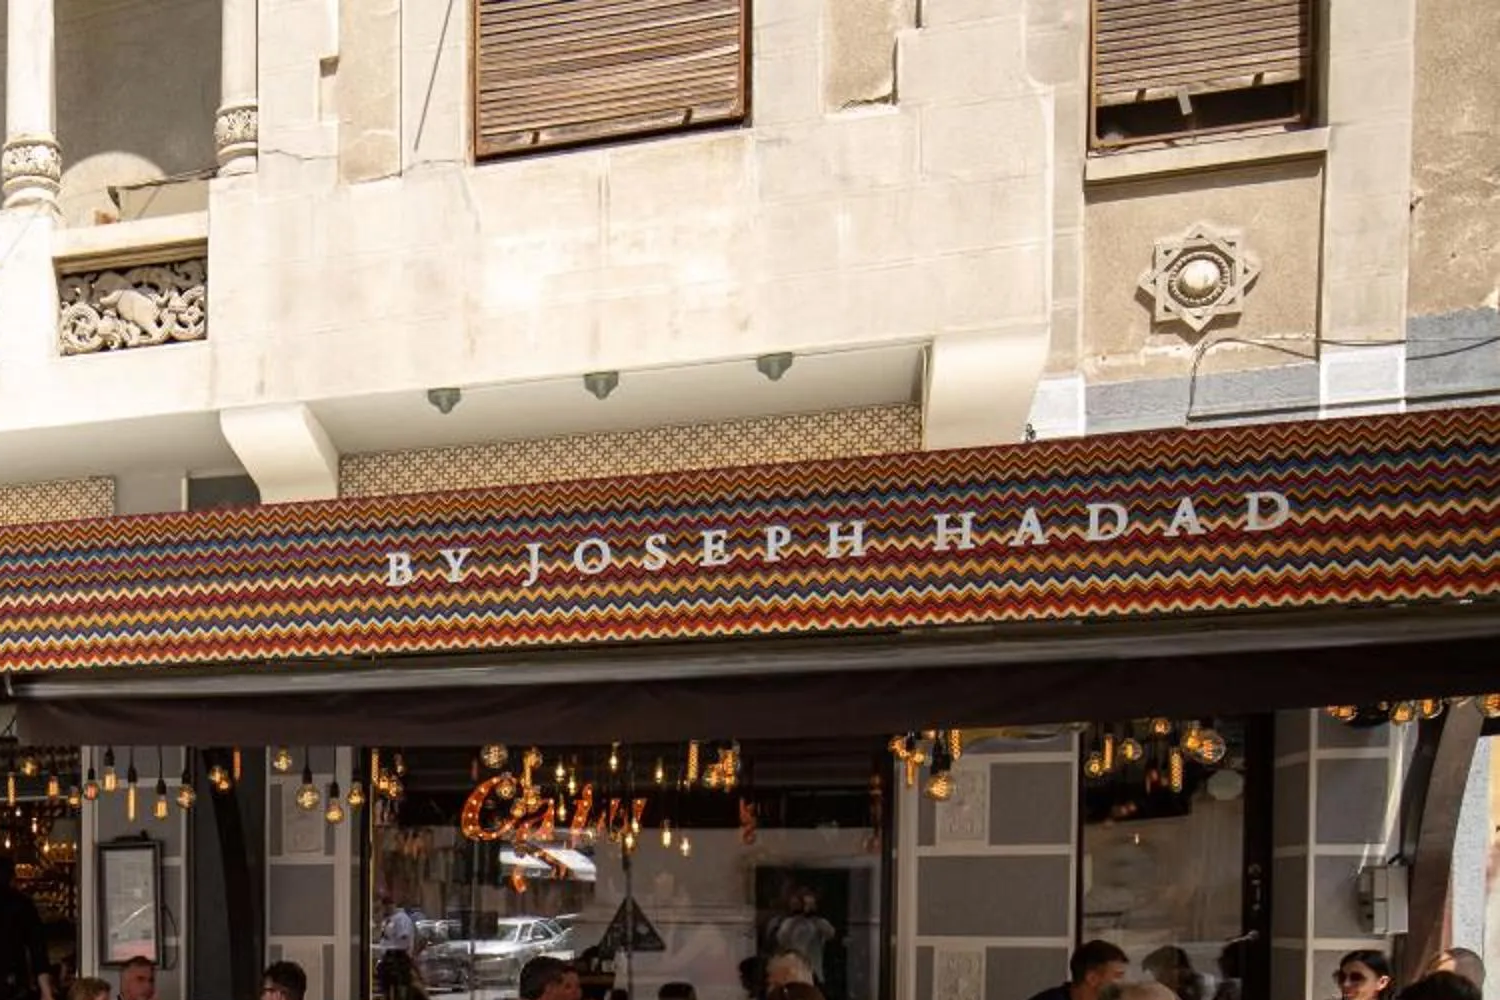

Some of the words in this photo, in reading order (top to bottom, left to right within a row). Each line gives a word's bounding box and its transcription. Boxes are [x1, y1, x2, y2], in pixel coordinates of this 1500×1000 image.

[386, 548, 471, 587] BY
[522, 519, 867, 587] JOSEPH
[933, 490, 1290, 551] HADAD
